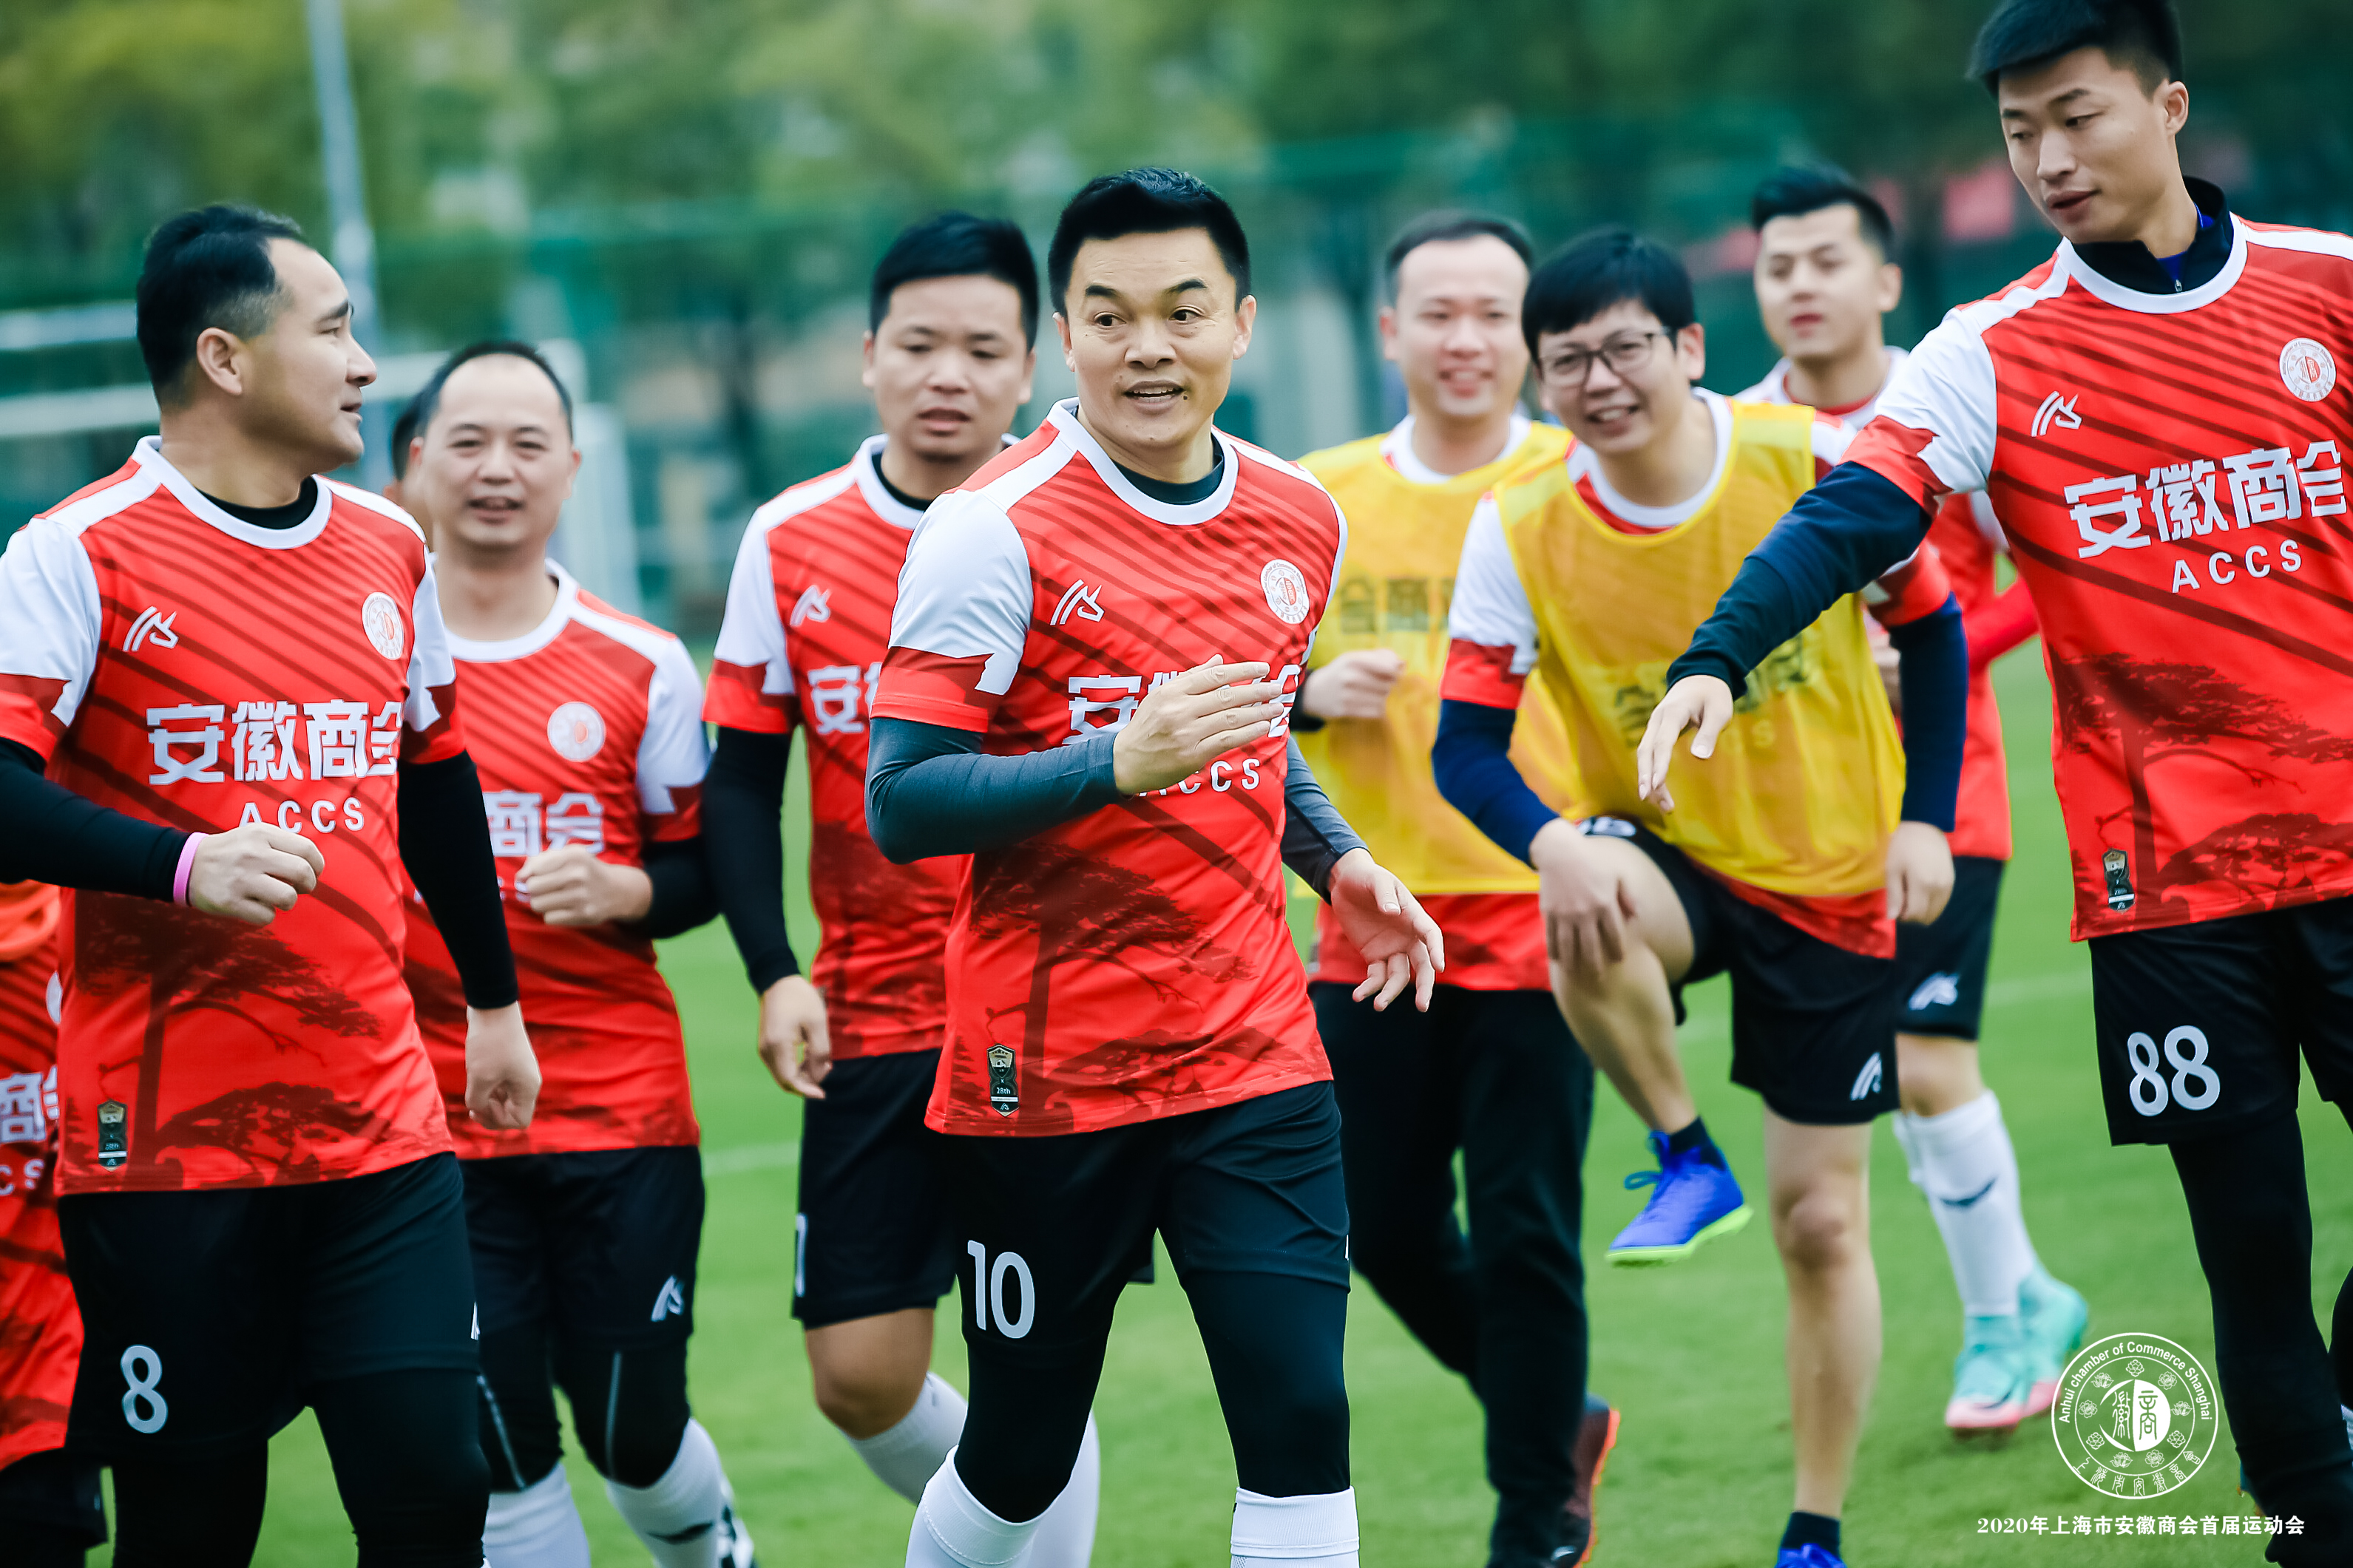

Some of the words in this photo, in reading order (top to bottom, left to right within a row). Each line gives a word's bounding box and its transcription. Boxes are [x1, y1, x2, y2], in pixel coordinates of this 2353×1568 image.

[2064, 440, 2347, 559] 安徽商会
[2172, 539, 2302, 594] ACCS
[146, 699, 403, 785] 安徽商会
[808, 662, 882, 735] 安
[1062, 665, 1301, 745] 安会
[2127, 1025, 2221, 1117] 88
[967, 1240, 1035, 1339] 10
[120, 1344, 169, 1434] 8
